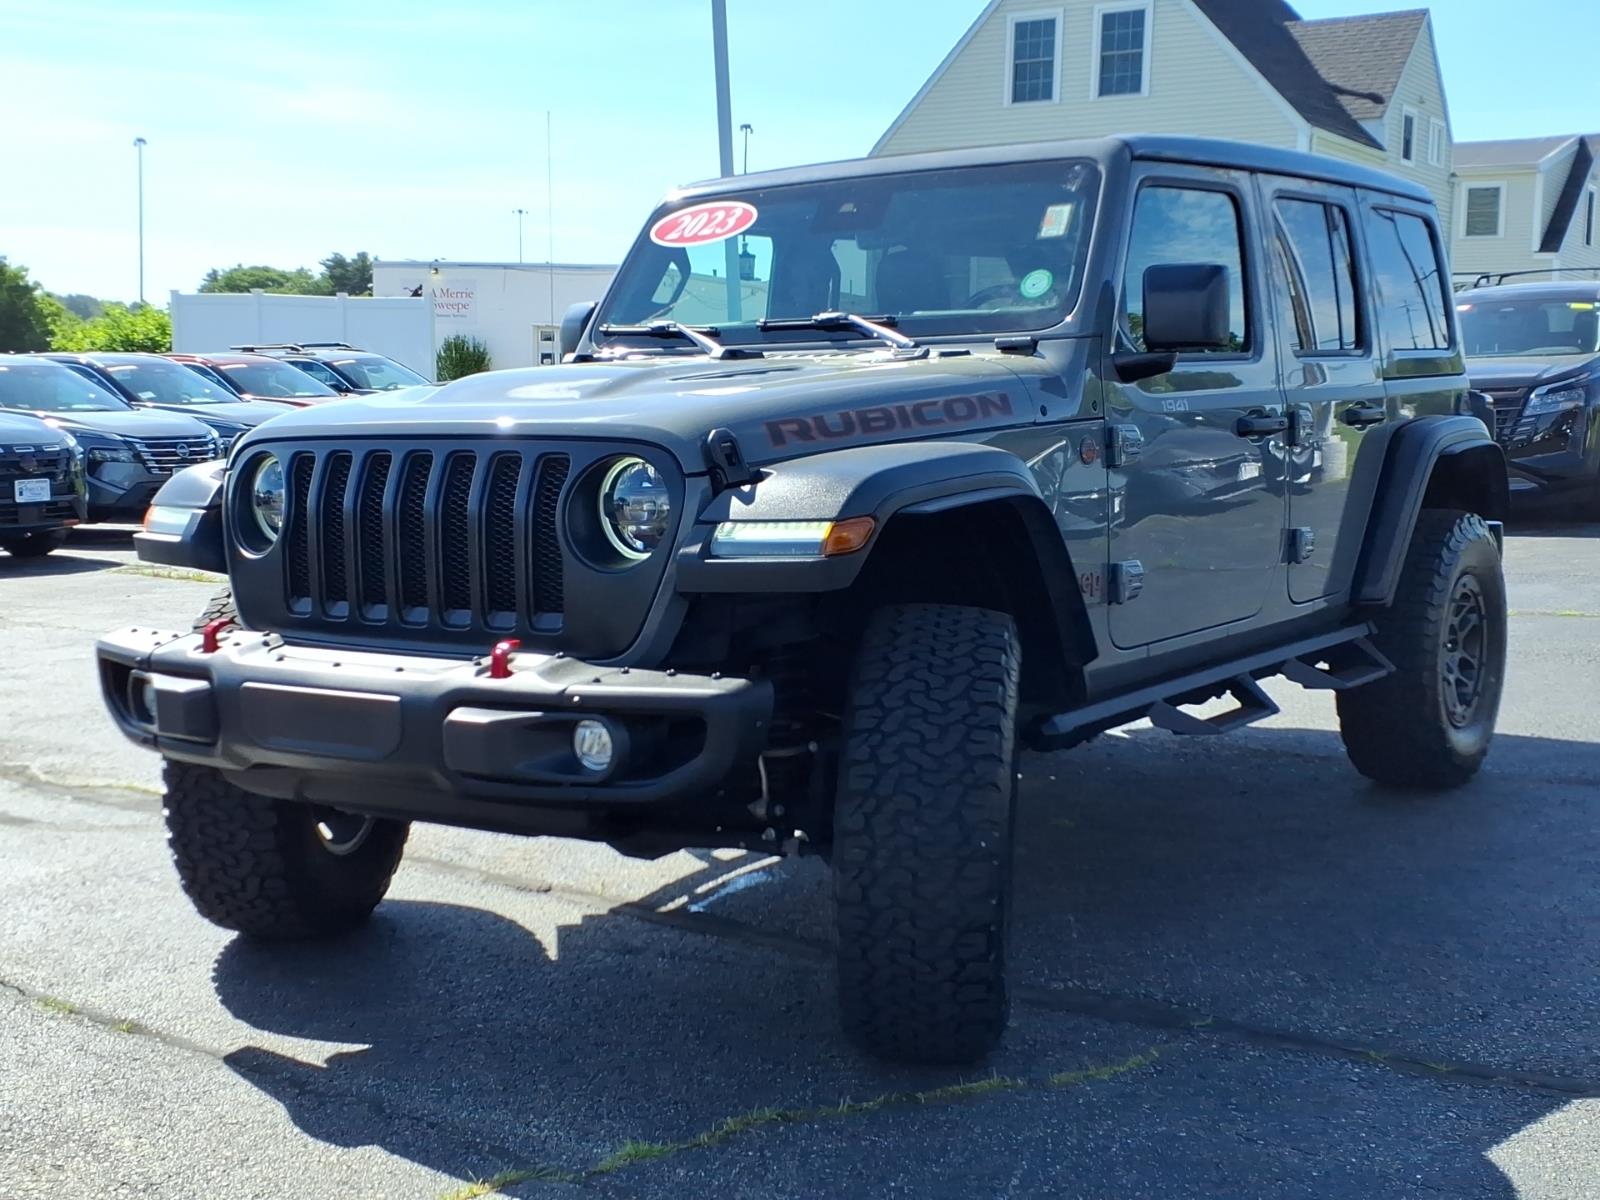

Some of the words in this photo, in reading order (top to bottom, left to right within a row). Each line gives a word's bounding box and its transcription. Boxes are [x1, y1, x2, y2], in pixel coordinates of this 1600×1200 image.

[664, 207, 744, 240] 2023
[440, 287, 474, 298] Merrie
[1161, 399, 1189, 412] 1941
[763, 391, 1014, 448] RUBICON
